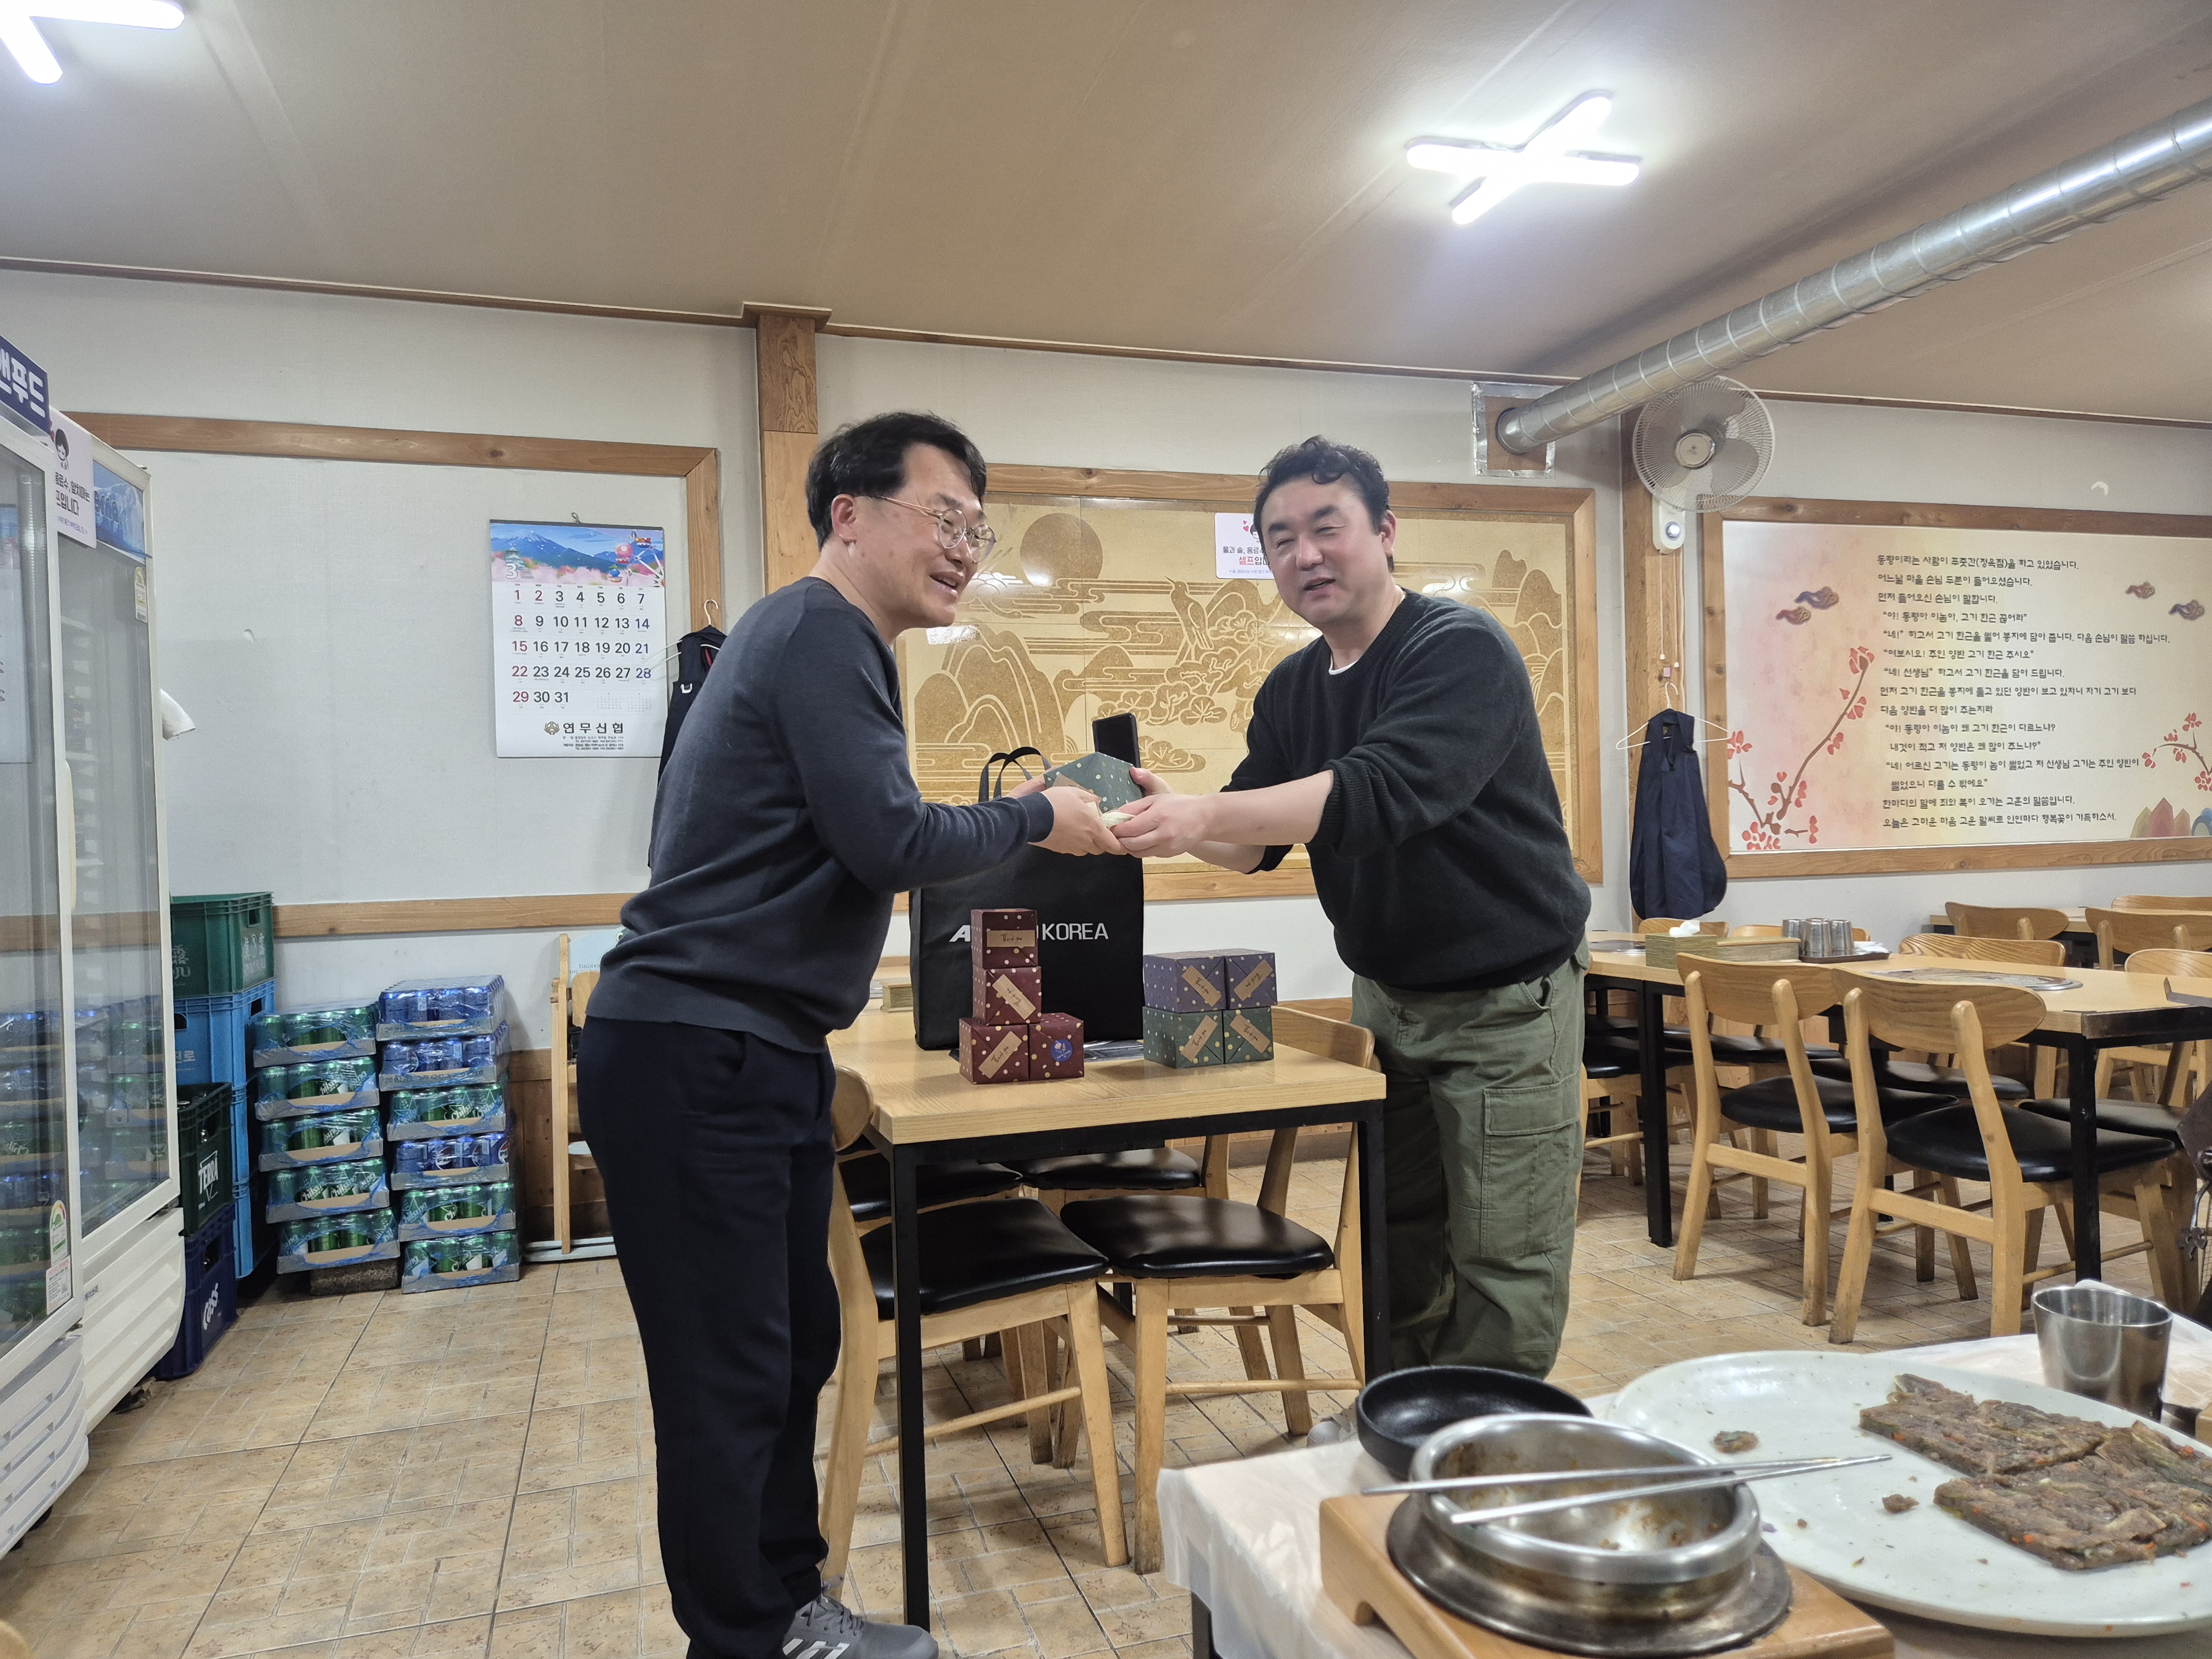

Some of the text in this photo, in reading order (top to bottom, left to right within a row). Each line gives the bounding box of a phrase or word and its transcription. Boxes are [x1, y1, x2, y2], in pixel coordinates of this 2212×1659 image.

[1922, 556, 1948, 567] 사람이
[2018, 559, 2035, 568] 하고
[505, 563, 518, 579] 3
[1877, 573, 2033, 588] 어느날 마을 손님 두분이 들어오셨습니다.
[514, 589, 645, 604] 1 2 3 4 5 6 7
[1877, 592, 1998, 605] 먼저 들어오신 손님이 말합니다.
[514, 614, 650, 630] 8 9 10 11 12 13 14
[1931, 612, 1958, 623] 이놈아,
[1960, 613, 1978, 622] 고기
[1980, 613, 1997, 623] 한근
[1907, 630, 1934, 639] 하고서
[1936, 631, 1954, 639] 고기
[1955, 631, 1981, 642] 한근을
[2002, 632, 2027, 643] 봉지에
[2030, 632, 2046, 642] 담아
[2048, 632, 2075, 643] 줍니다.
[2077, 633, 2093, 644] 다음
[2094, 633, 2118, 643] 손님이
[2120, 633, 2136, 644] 말씀
[2137, 634, 2170, 644] 하십니다.
[512, 640, 649, 654] 15 16 17 18 19 20 21
[1928, 649, 1946, 659] 주인
[1948, 649, 1965, 660] 양반
[1967, 650, 1984, 658] 고기
[1986, 650, 2004, 660] 한근
[2005, 650, 2034, 660] 주시오”
[512, 665, 651, 679] 22 23 24 25 26 27 28
[1903, 667, 1933, 679] 선생님”
[1937, 667, 1963, 677] 하고서
[1965, 668, 1982, 677] 고기
[1984, 668, 2010, 679] 한근을
[2012, 668, 2028, 679] 담아
[2030, 669, 2065, 679] 드립니다.
[512, 691, 568, 703] 29 30 31
[1879, 686, 2137, 698] 먼저 고기 한근을 봉지에 들고 있던 양반이 보고 있자니 자기 고기 보다
[1880, 705, 1993, 716] 다음 양반을 더 많이 주는지라
[1933, 723, 1958, 734] 이놈아
[1960, 723, 1970, 732] 왜
[1971, 723, 1989, 732] 고기
[1991, 723, 2016, 734] 한근이
[2018, 723, 2056, 732] 다르느냐?
[1890, 743, 1916, 753] 내것이
[1918, 743, 1936, 753] 적고
[1938, 742, 1947, 751] 저
[1949, 742, 1975, 753] 양반은
[1977, 742, 1986, 750] 왜
[1988, 742, 2005, 753] 많이
[1905, 761, 1931, 771] 어르신
[1933, 761, 1959, 771] 고기는
[1989, 760, 2006, 771] 놈이
[2008, 760, 2033, 771] 썰었고
[2035, 759, 2044, 768] 저
[2046, 759, 2070, 770] 선생님
[2072, 759, 2096, 769] 고기는
[2098, 758, 2114, 768] 주인
[2116, 758, 2139, 769] 양반이
[1891, 780, 1925, 791] 썰었으니
[1947, 779, 1957, 789] 수
[1882, 795, 2075, 810] 한마디의 말에 죄와 복이 오가는 교훈의 말씀입니다.
[1882, 812, 2117, 829] 오늘은 고마운 마음 고운 말씨로 인연마다 행복꽃이 가득하소서.
[1042, 922, 1109, 940] KOREA
[198, 1157, 218, 1194] TERRA
